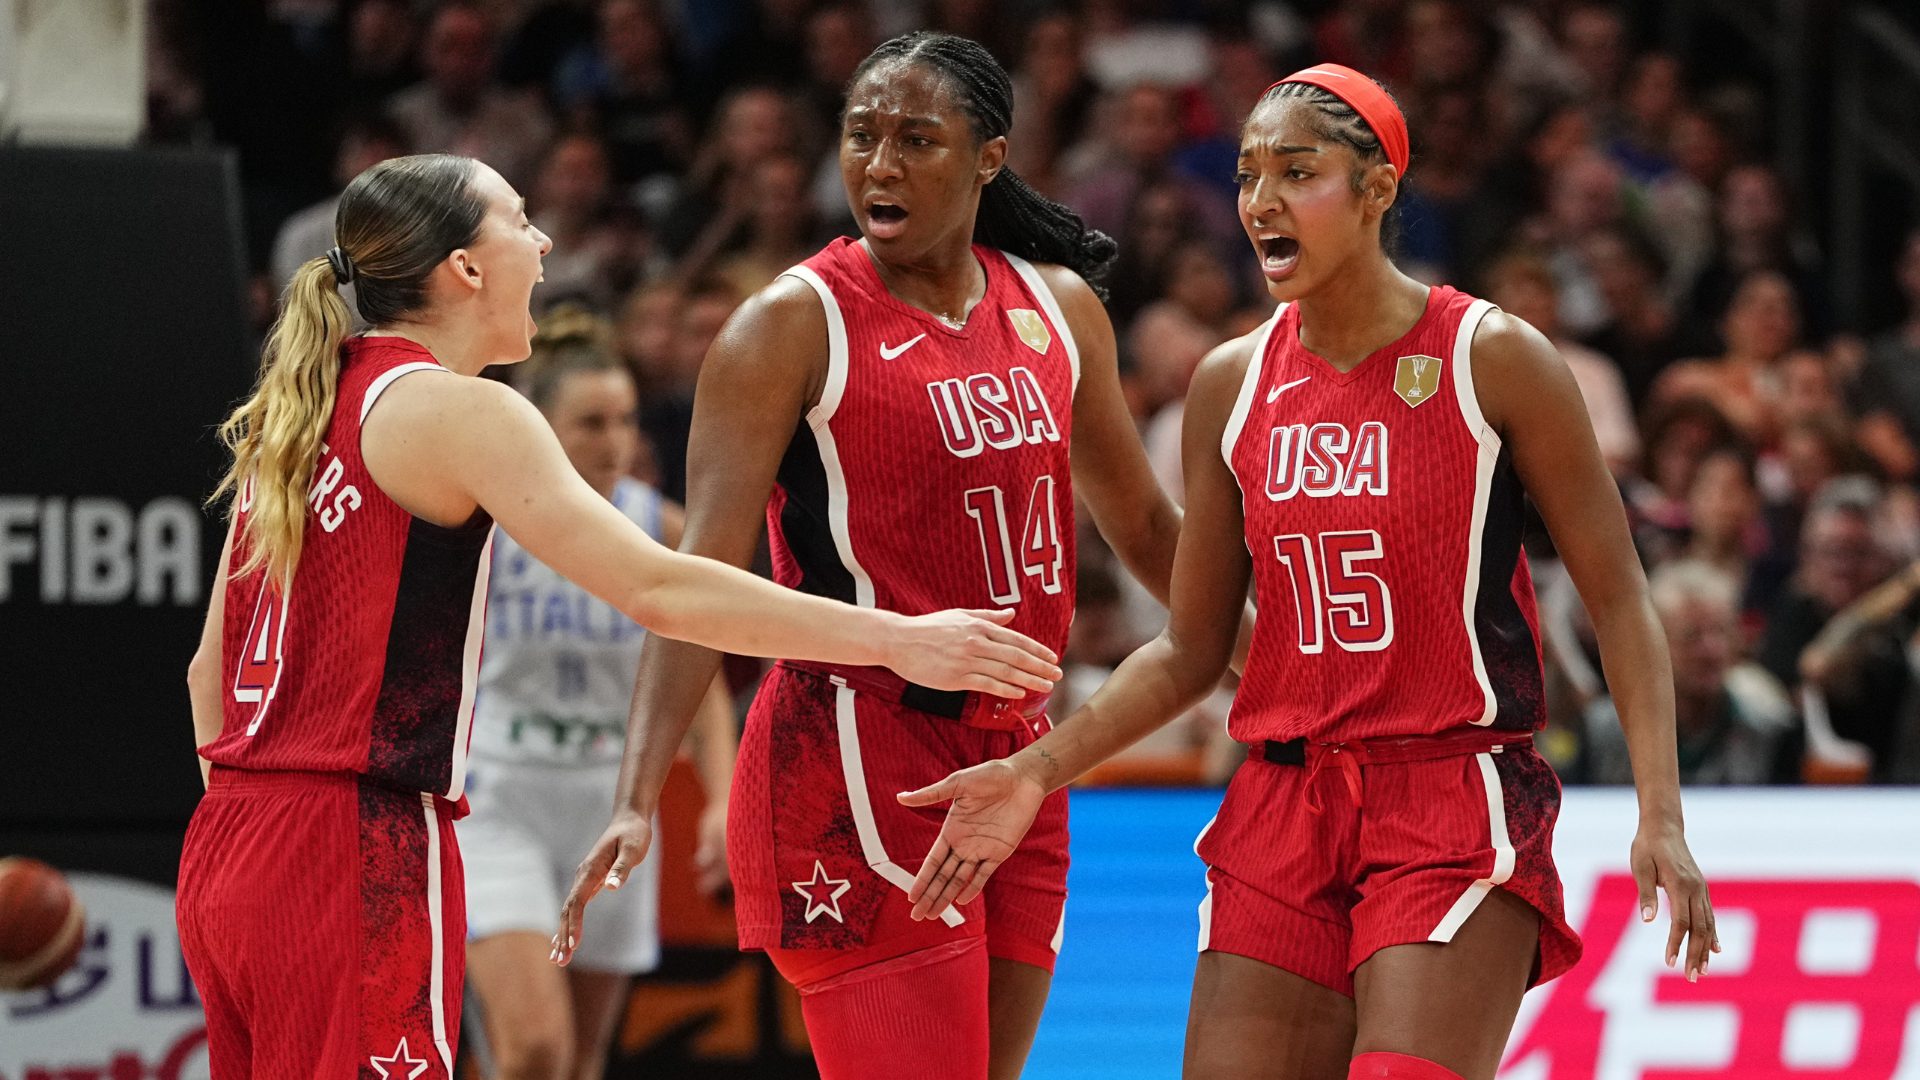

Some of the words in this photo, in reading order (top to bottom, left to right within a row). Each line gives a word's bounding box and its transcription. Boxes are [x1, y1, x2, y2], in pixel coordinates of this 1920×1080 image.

[927, 366, 1060, 459] USA
[1265, 421, 1388, 502] USA
[0, 494, 201, 605] FIBA
[964, 474, 1062, 606] 14
[1273, 529, 1394, 655] 15
[234, 556, 291, 736] 4
[494, 587, 645, 642] ITALI
